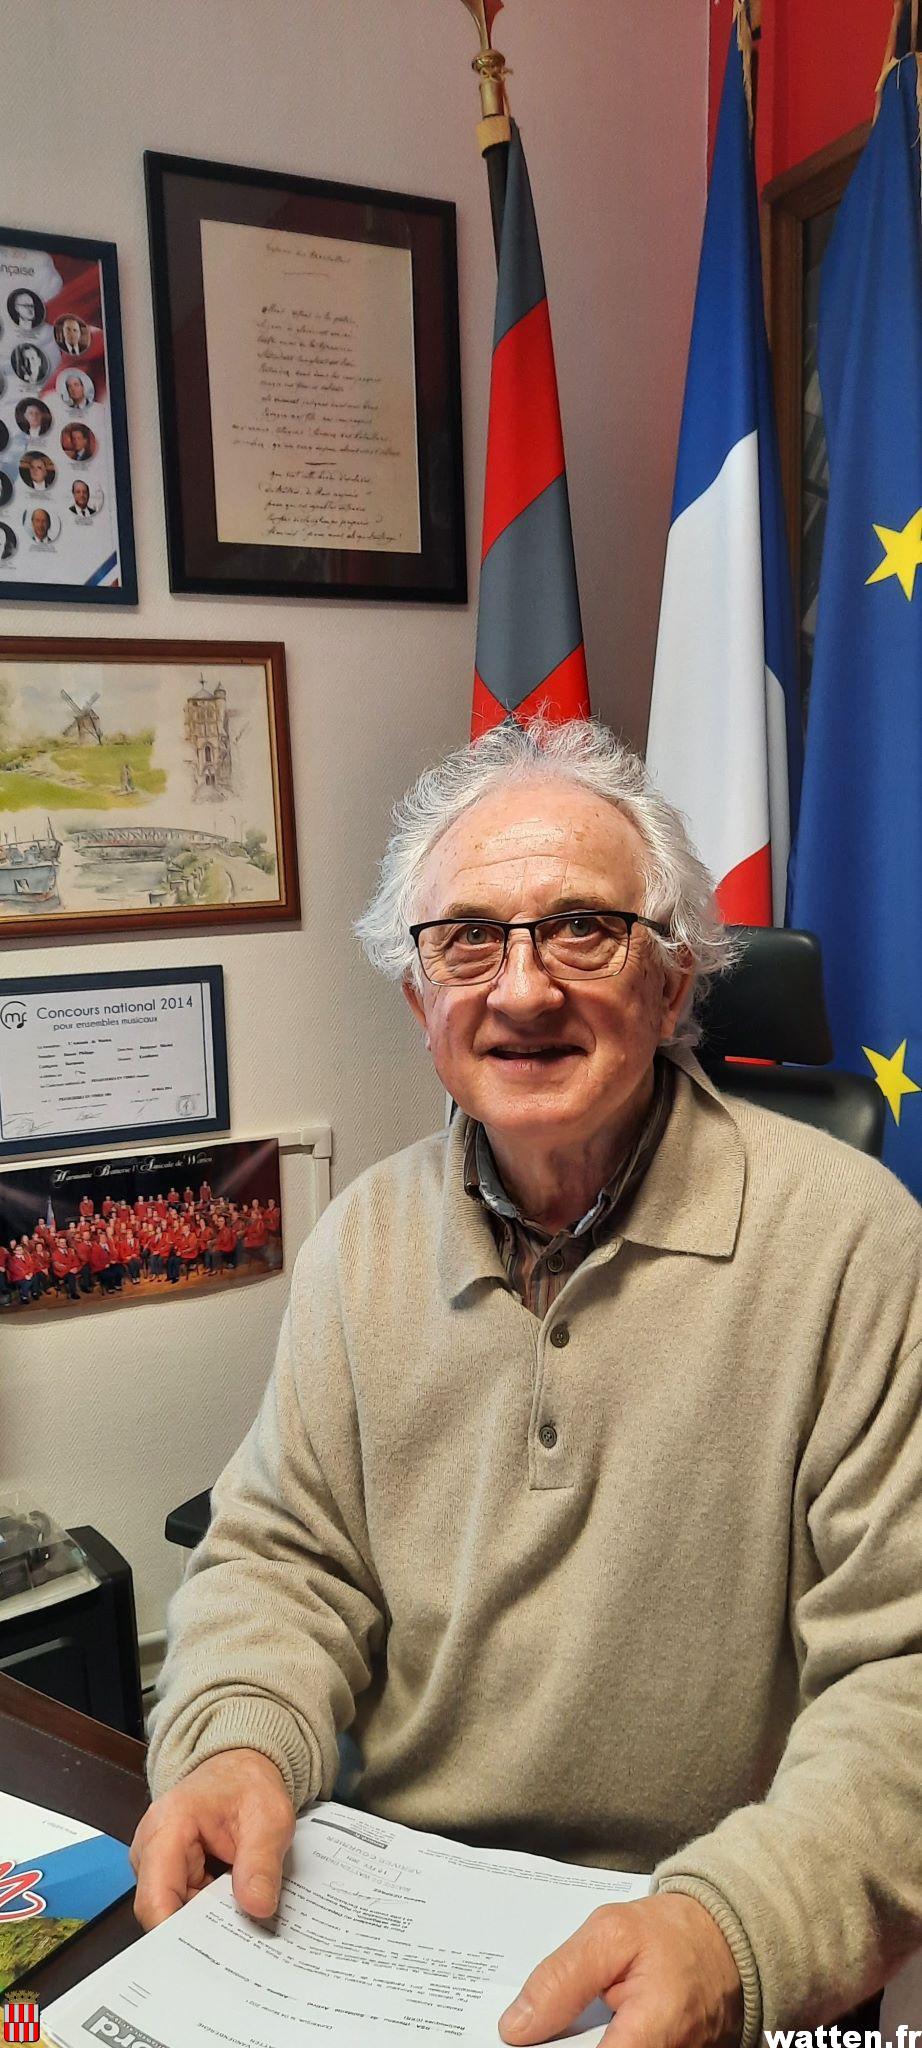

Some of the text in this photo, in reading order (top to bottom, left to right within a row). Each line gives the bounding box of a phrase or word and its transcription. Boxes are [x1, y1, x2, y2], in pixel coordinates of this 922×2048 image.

[37, 1005, 100, 1020] Concours
[104, 1000, 156, 1014] national
[161, 996, 193, 1010] 2014
[54, 1016, 158, 1032] pour ensembles musicaux
